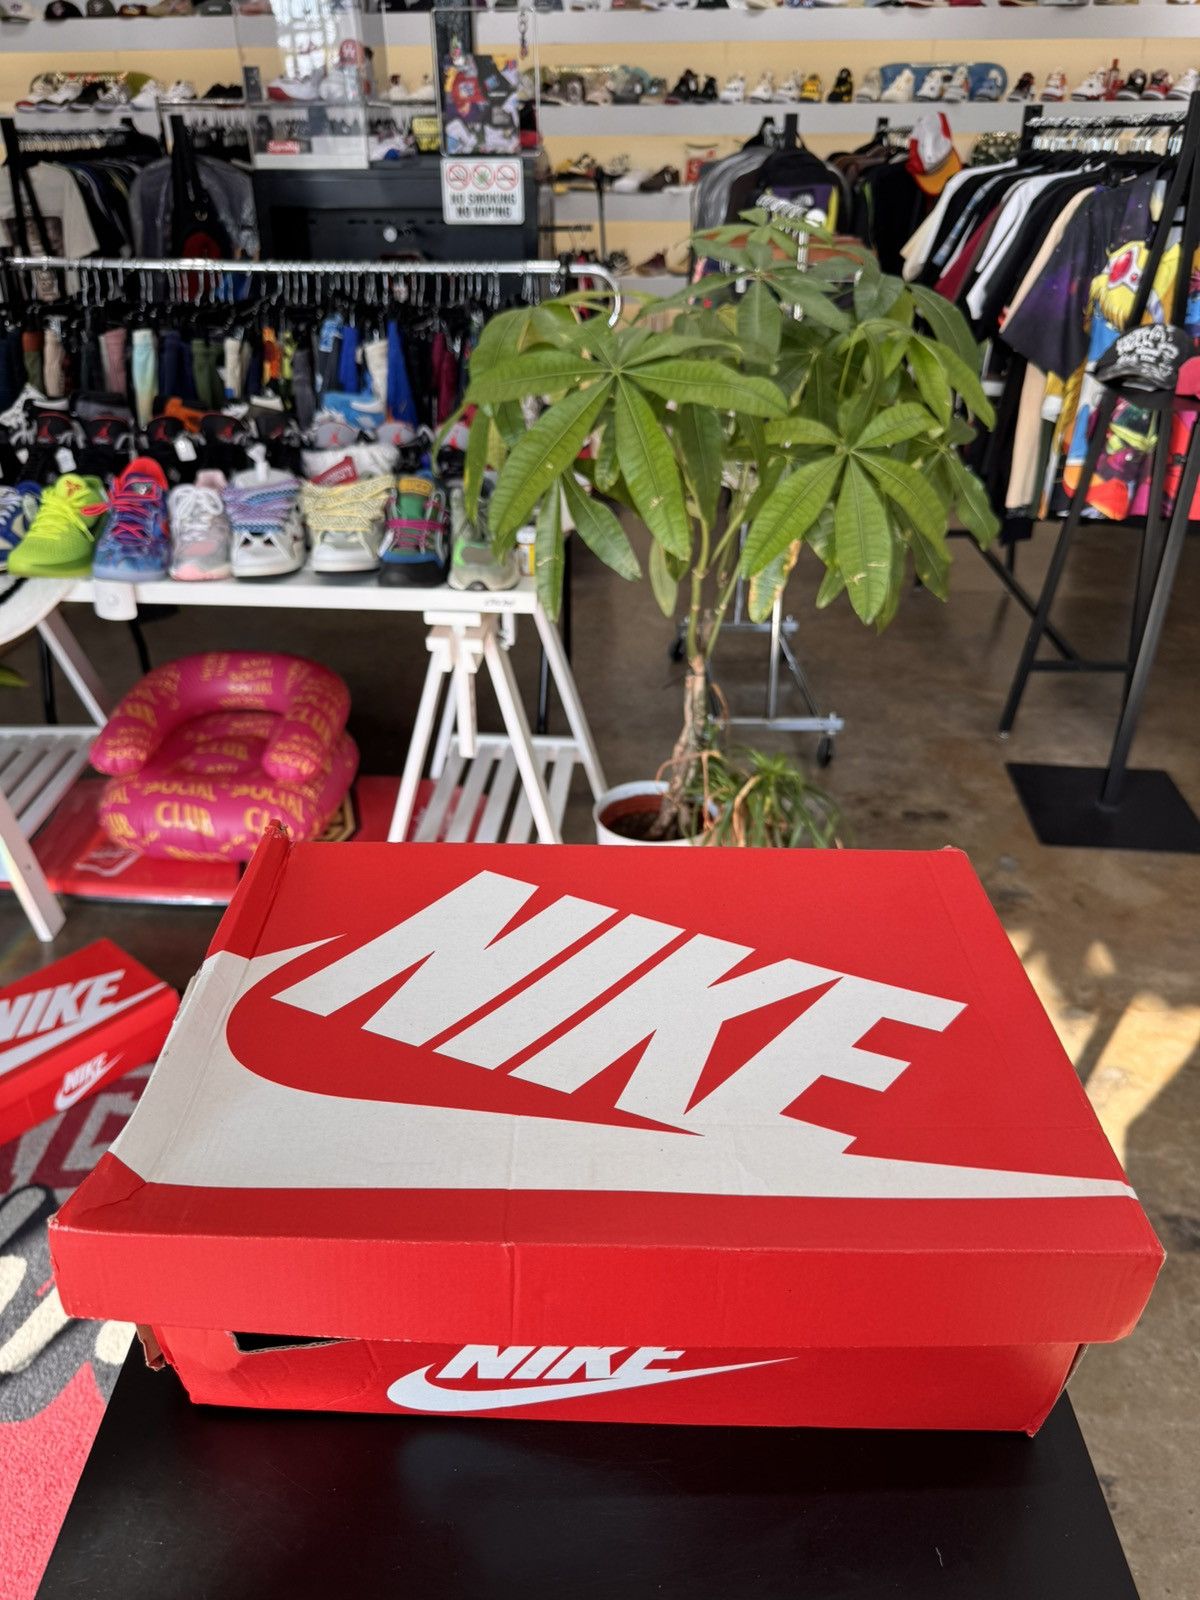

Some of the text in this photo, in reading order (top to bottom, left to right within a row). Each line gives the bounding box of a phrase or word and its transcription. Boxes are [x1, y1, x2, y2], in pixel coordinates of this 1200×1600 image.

[467, 193, 515, 205] SMOKING
[270, 869, 968, 1153] NIKE
[64, 1051, 109, 1092] NIKE
[436, 1344, 686, 1380] NIKE
